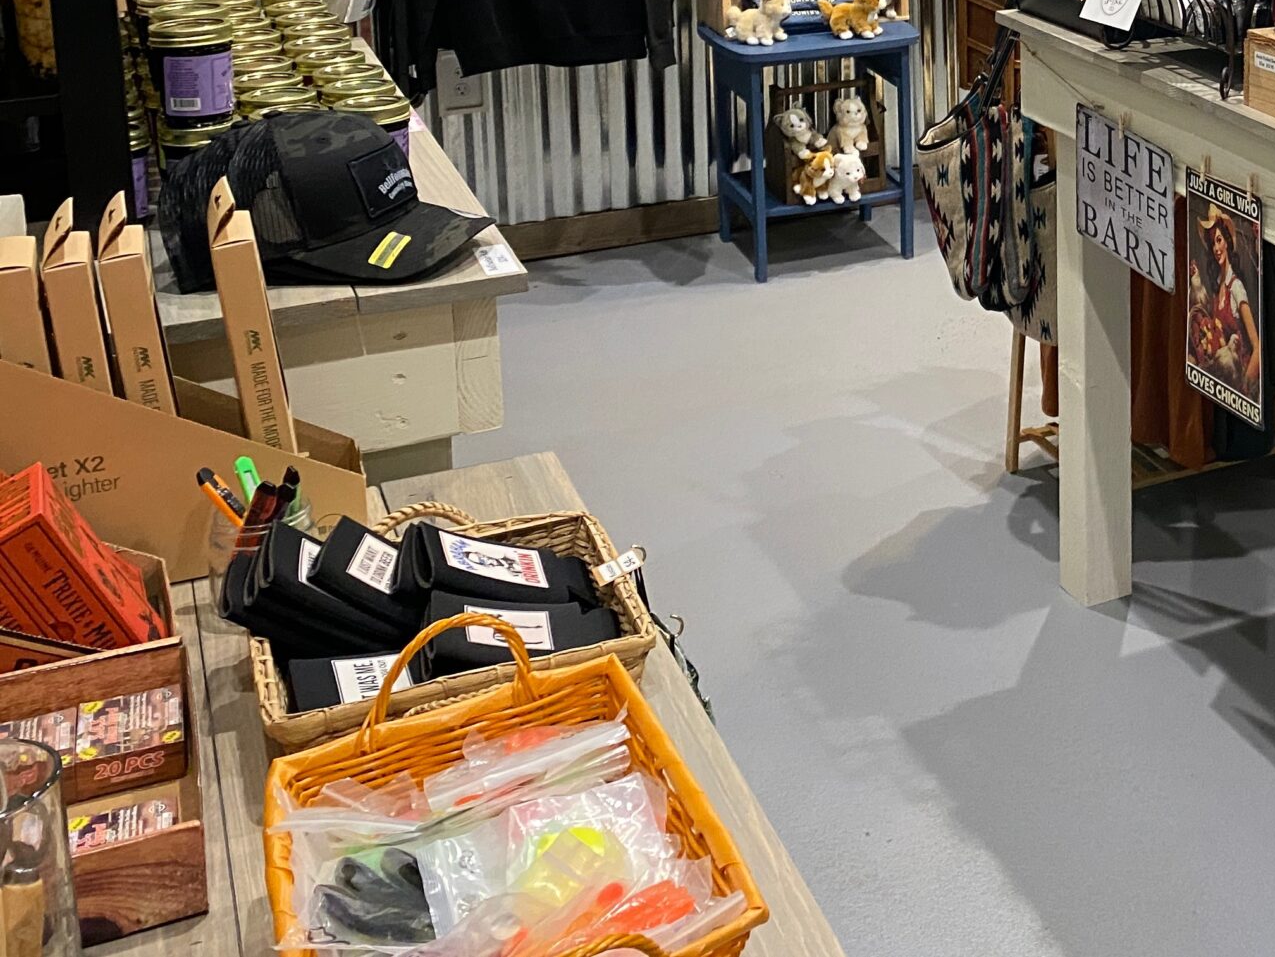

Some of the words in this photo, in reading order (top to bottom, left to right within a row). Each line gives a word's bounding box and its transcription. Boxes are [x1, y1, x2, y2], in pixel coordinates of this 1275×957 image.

[1082, 111, 1168, 199] LIFE
[1082, 156, 1096, 183] IS
[1104, 170, 1169, 229] BETTER
[1188, 172, 1207, 193] JUST
[1208, 183, 1216, 198] A
[1216, 187, 1235, 208] GIRL
[1236, 194, 1258, 218] WHO
[1104, 197, 1116, 212] IN
[1120, 206, 1143, 229] THE
[1082, 200, 1167, 286] BARN
[250, 360, 266, 387] MADE
[255, 387, 272, 406] FOR
[1187, 367, 1214, 396] LOVES
[1215, 383, 1260, 423] CHICKENS
[260, 406, 275, 423] THE
[75, 455, 106, 476] X2
[64, 475, 121, 503] ighter
[43, 567, 93, 625] TRIXIE
[354, 660, 374, 674] ME.
[357, 675, 380, 693] WAS
[93, 760, 122, 780] 20
[125, 750, 165, 774] PCS
